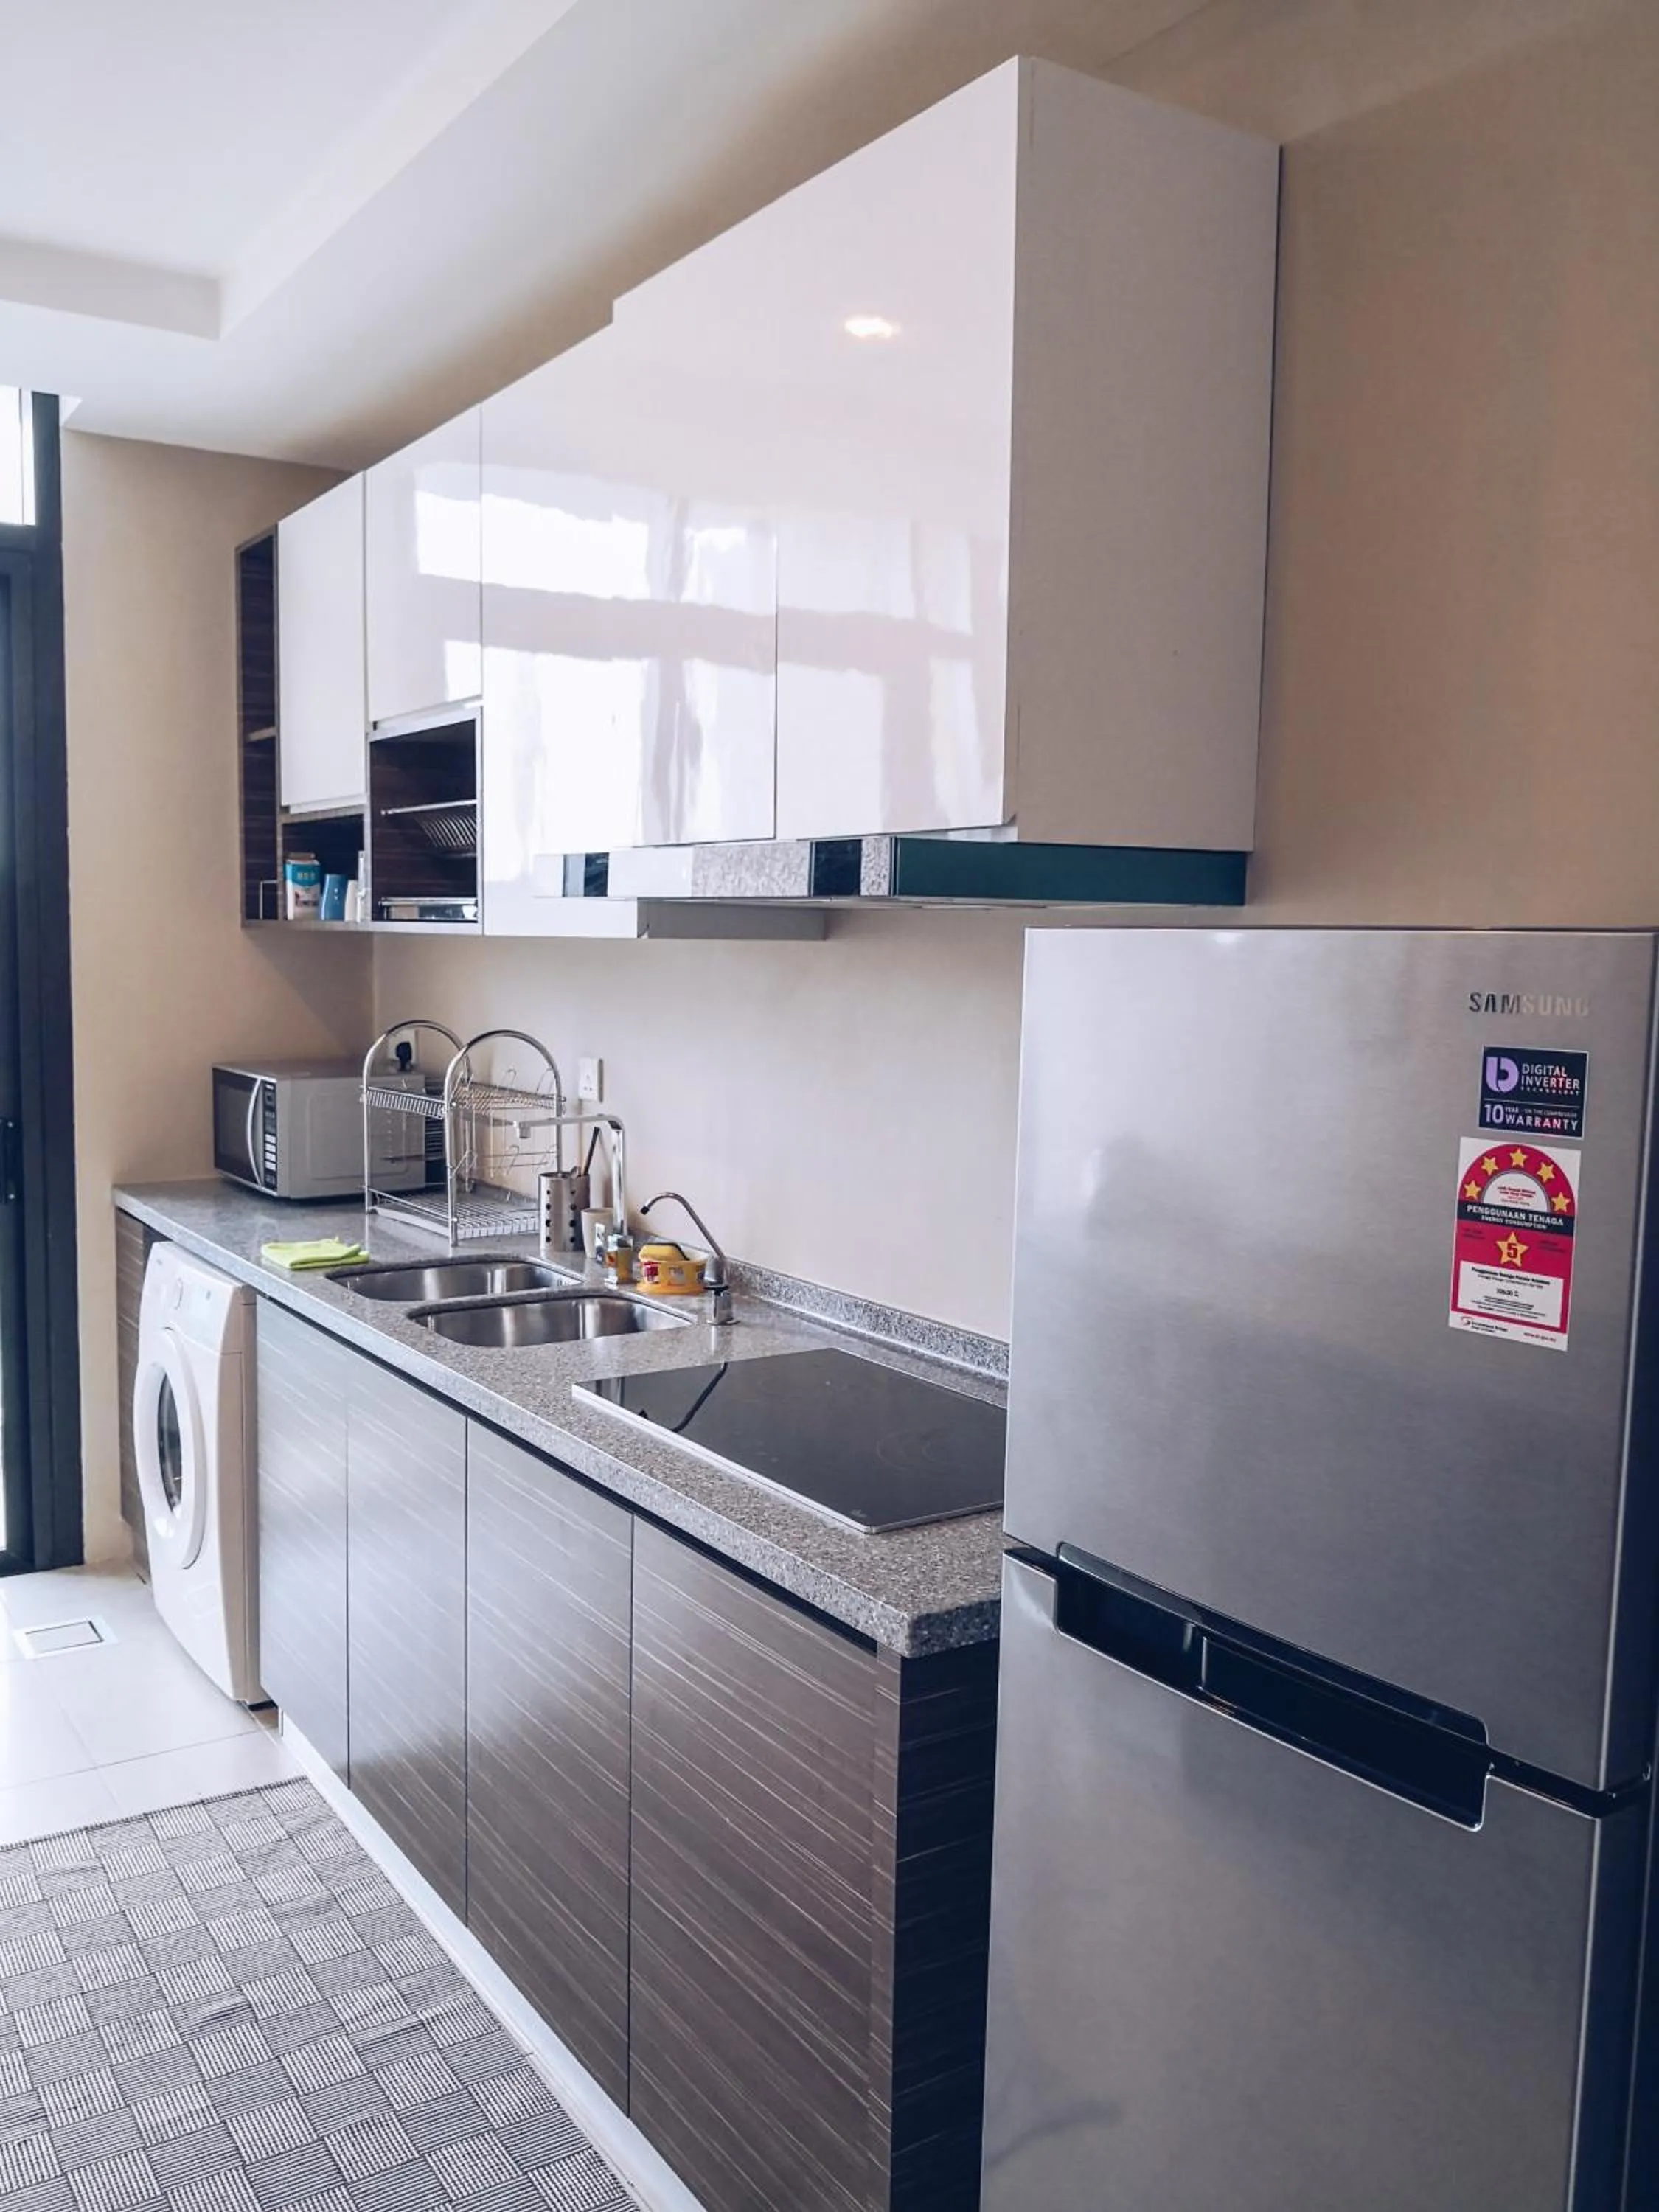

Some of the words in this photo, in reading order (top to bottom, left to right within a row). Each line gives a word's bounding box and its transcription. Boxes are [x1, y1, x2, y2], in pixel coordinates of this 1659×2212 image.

[1469, 992, 1590, 1016] SAMSUNG
[1522, 1063, 1567, 1077] DIGITAL
[1521, 1075, 1580, 1090] INVERTER
[1484, 1104, 1503, 1124] 10
[1505, 1114, 1578, 1130] WARRANTY
[1467, 1204, 1526, 1220] PENGGUNAAN
[1528, 1213, 1563, 1226] TENAGA
[1506, 1243, 1518, 1259] 5
